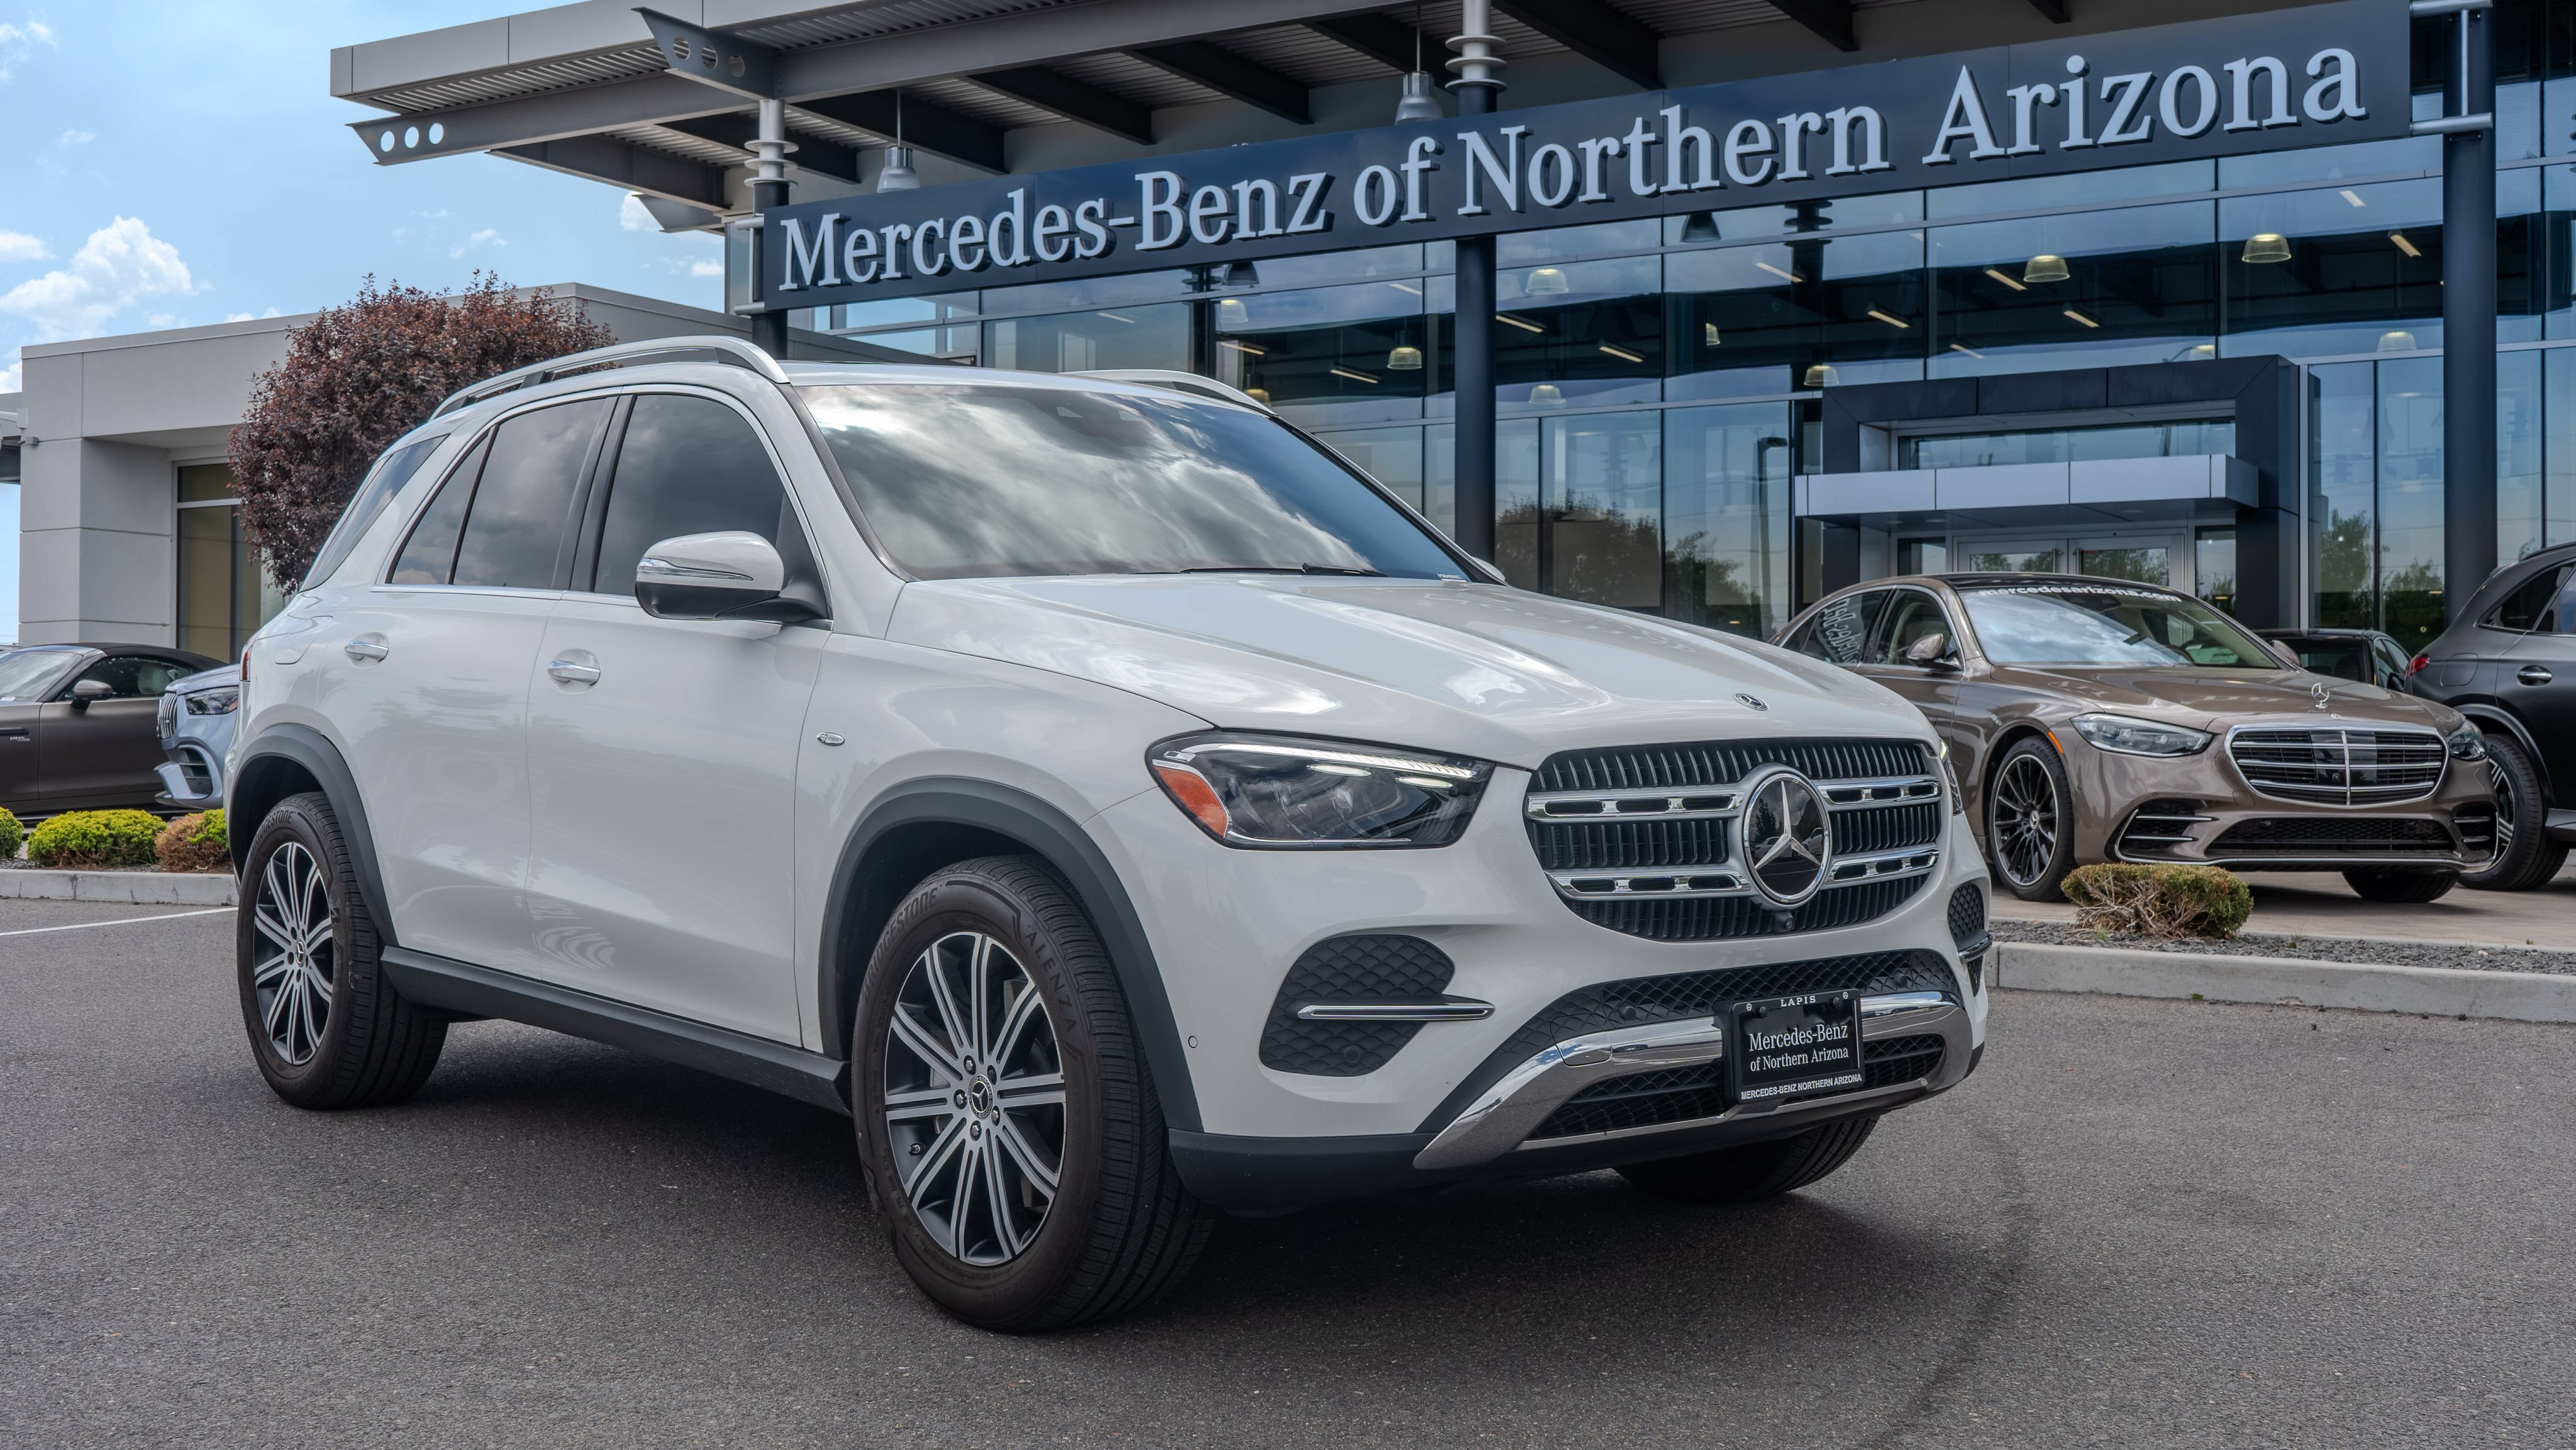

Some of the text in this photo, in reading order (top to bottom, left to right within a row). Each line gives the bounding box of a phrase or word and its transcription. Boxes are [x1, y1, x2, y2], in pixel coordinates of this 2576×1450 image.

[779, 48, 2366, 291] Mercedes-Benz of Northern Arizona
[1978, 585, 2182, 602] mercedesarizona.com
[861, 887, 938, 1004] BRIDGESTONE
[1024, 931, 1077, 1033] ALENZA
[1780, 995, 1816, 1007] LAPIS
[1748, 1023, 1848, 1052] Mercedes-Benz
[1750, 1047, 1849, 1072] of Northern Arizona
[1741, 1073, 1862, 1100] MERCEDES-BENZ NORTHERN ARIZONA
